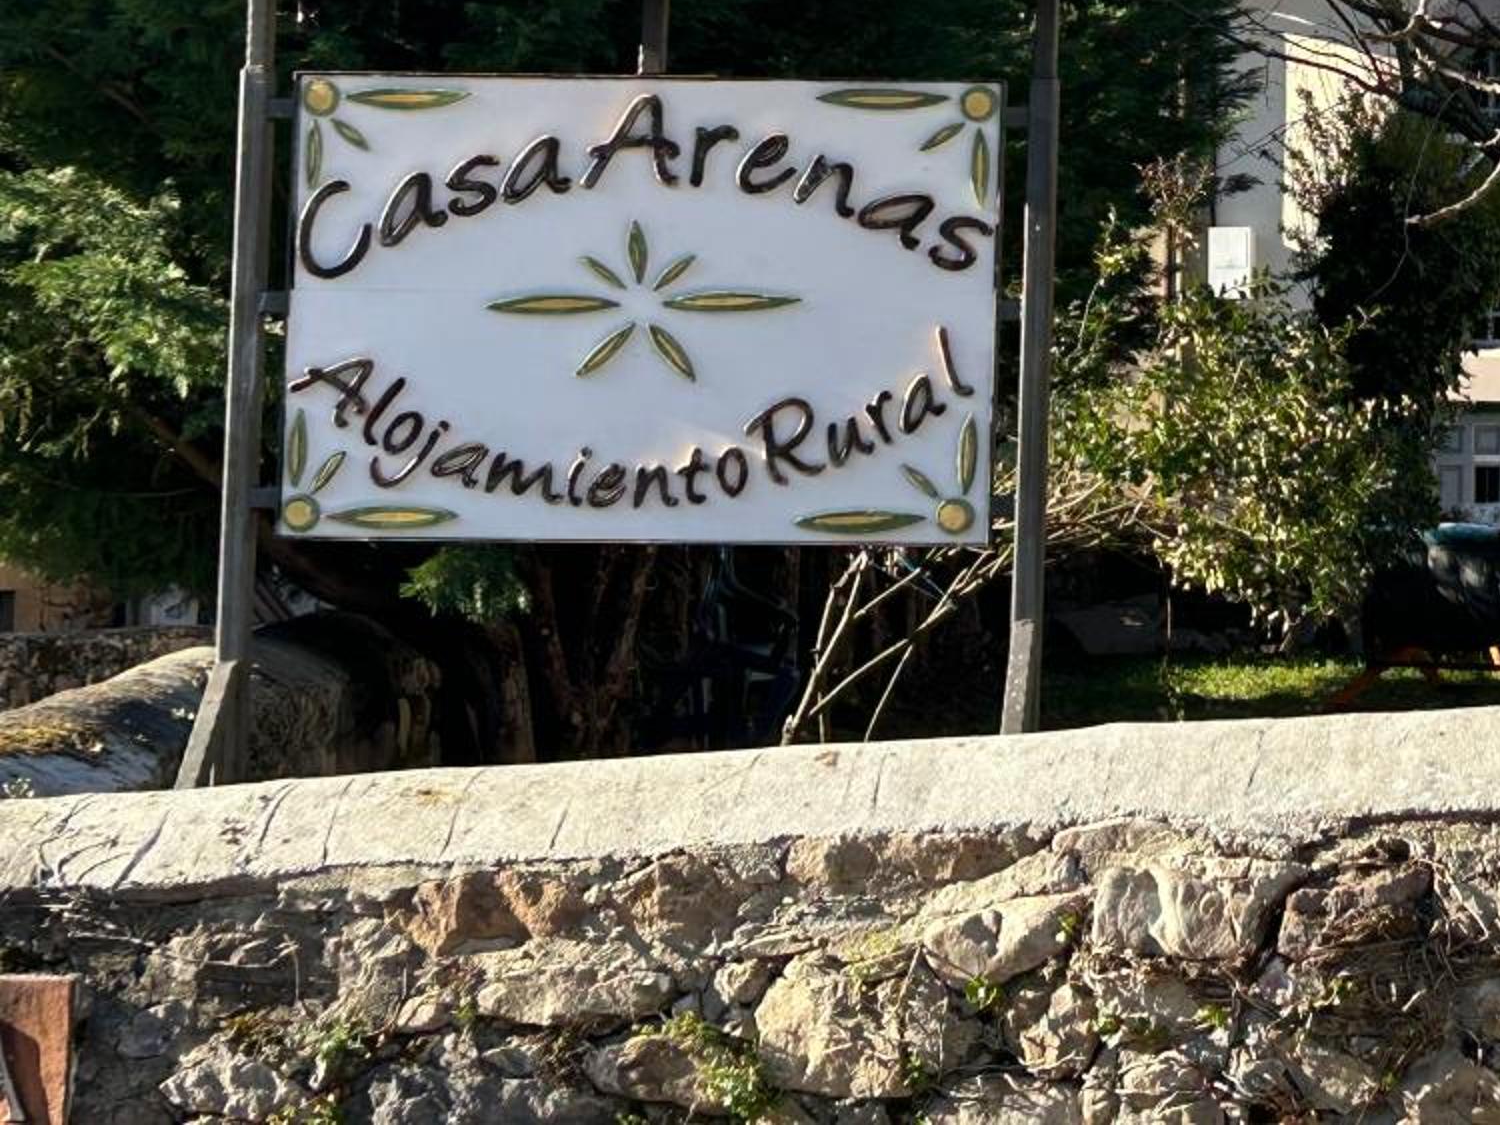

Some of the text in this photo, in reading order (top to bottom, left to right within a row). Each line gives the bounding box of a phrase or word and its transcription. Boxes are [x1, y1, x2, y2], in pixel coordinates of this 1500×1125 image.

[299, 93, 995, 279] Casa Arenas
[288, 325, 975, 508] Alojamiento Rural
